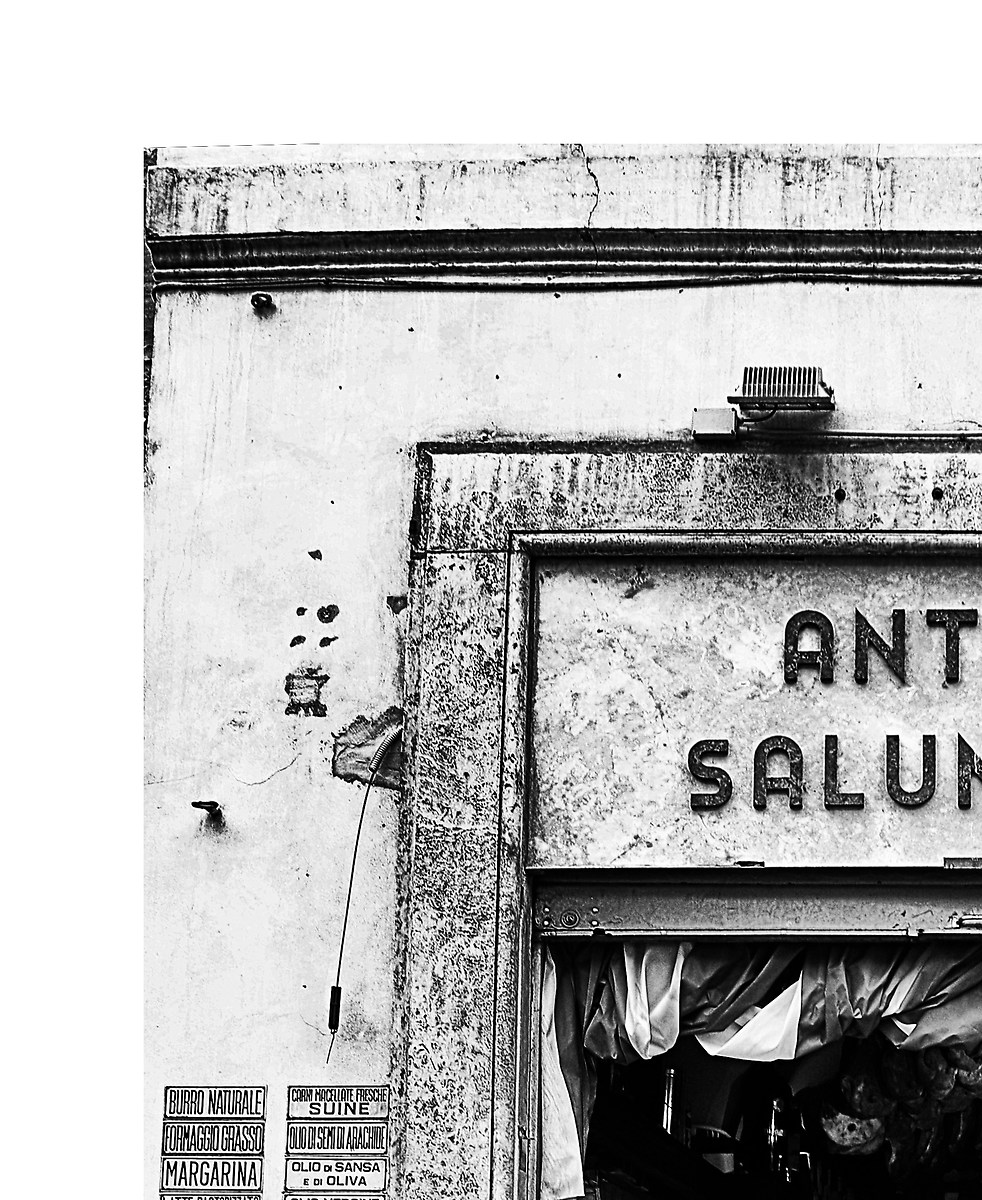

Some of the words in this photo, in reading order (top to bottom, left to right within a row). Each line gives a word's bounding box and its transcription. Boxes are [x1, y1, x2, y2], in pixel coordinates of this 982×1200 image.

[169, 1089, 204, 1115] BURRO
[208, 1089, 262, 1115] NATURALE
[292, 1088, 313, 1102] CARNI
[315, 1088, 353, 1102] MACELLATE
[355, 1088, 388, 1102] FRESCHE
[309, 1102, 370, 1115] SUINE
[165, 1125, 220, 1152] FORMAGGIO
[221, 1125, 262, 1152] GRASSO
[289, 1126, 307, 1150] OLIO
[308, 1126, 316, 1150] DI
[317, 1126, 335, 1150] SEMI
[336, 1126, 345, 1150] DI
[346, 1126, 386, 1150] ARACHIDE
[165, 1161, 258, 1187] MARGARINA
[292, 1162, 321, 1172] OLIO
[334, 1161, 381, 1173] SANSA
[303, 1178, 310, 1186] E
[313, 1178, 323, 1186] DI
[326, 1175, 367, 1187] OLIVA
